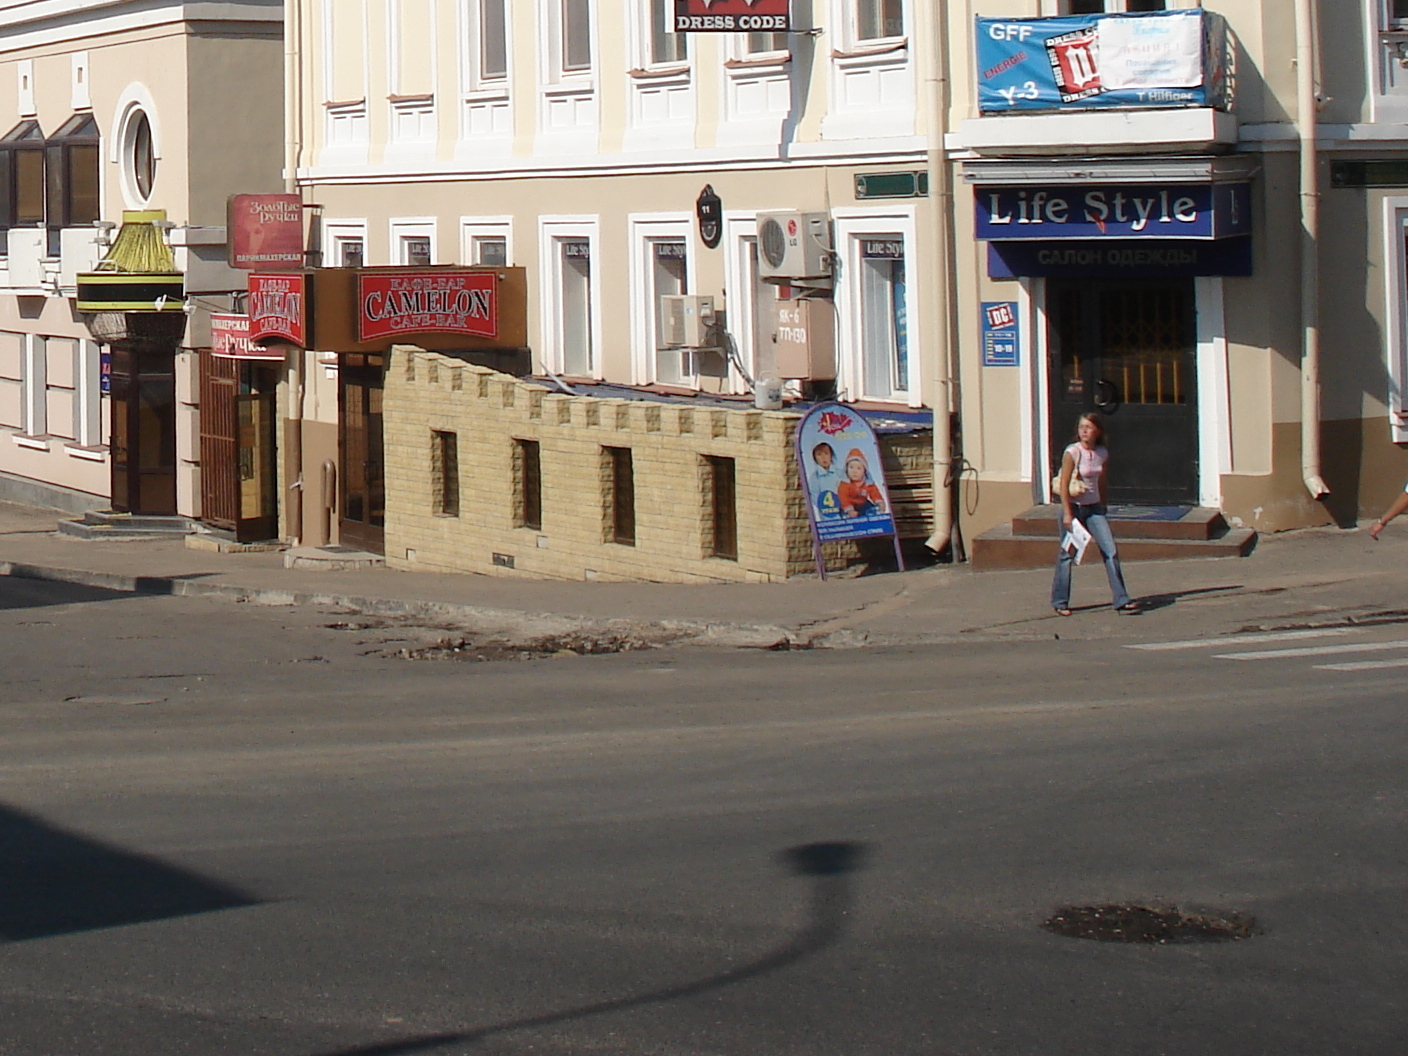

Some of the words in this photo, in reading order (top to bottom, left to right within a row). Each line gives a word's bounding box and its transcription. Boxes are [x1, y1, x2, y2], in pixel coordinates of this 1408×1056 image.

[677, 16, 735, 30] DRESS
[739, 16, 786, 29] CODE
[989, 23, 1033, 42] GFF
[984, 51, 1027, 79] ENERGIE
[998, 81, 1039, 105] Y-3
[701, 205, 710, 214] 11
[989, 190, 1069, 224] Life
[1083, 190, 1197, 232] Style
[236, 253, 301, 262] ПАРИКМАХЕРСКАЯ
[1037, 249, 1100, 265] САЛОН
[1107, 249, 1197, 267] ОДЕЖДЫ
[390, 278, 466, 290] КАФЕ-БАР
[250, 291, 301, 327] CAMELON
[365, 289, 492, 322] CAMELON
[390, 314, 467, 329] CAFE-BAR
[823, 491, 835, 508] 4
